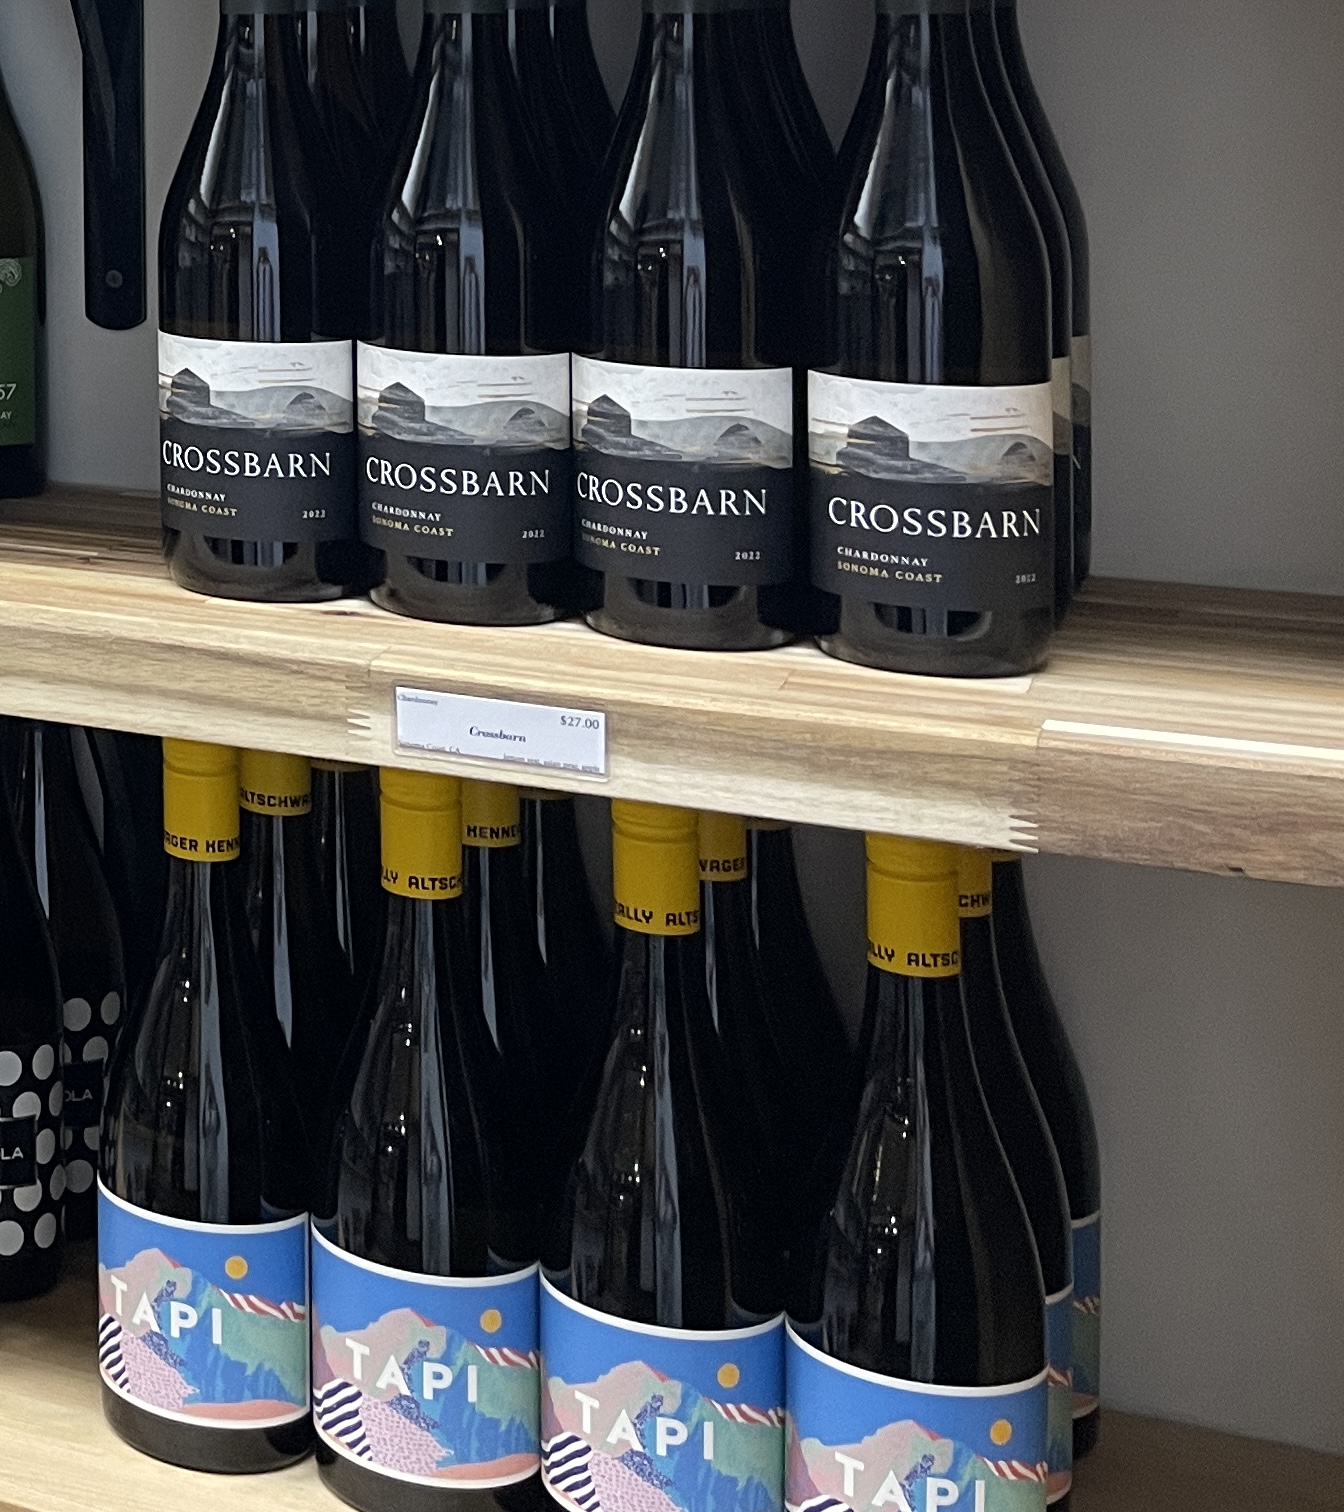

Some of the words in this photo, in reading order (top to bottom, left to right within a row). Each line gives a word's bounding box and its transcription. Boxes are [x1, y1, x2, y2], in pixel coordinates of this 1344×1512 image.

[163, 440, 331, 477] CROSSBARN
[366, 456, 549, 497] CROSSBARN
[166, 484, 226, 502] CHARDONNAY
[372, 501, 441, 522] CHARDONNAY
[577, 472, 767, 516] CROSSBARN
[582, 518, 648, 541] CHARDONNAY
[828, 497, 1040, 540] CROSSBARN
[837, 546, 929, 567] CHARDONNAY
[837, 561, 889, 579] SONOMA
[895, 571, 943, 584] COAST
[469, 726, 526, 743] Crossbarn
[561, 716, 600, 729] $27.00
[111, 1275, 222, 1344] TAPI
[345, 1338, 478, 1402] TAPI
[574, 1391, 712, 1460] TAPI
[834, 1451, 986, 1512] TAPI
